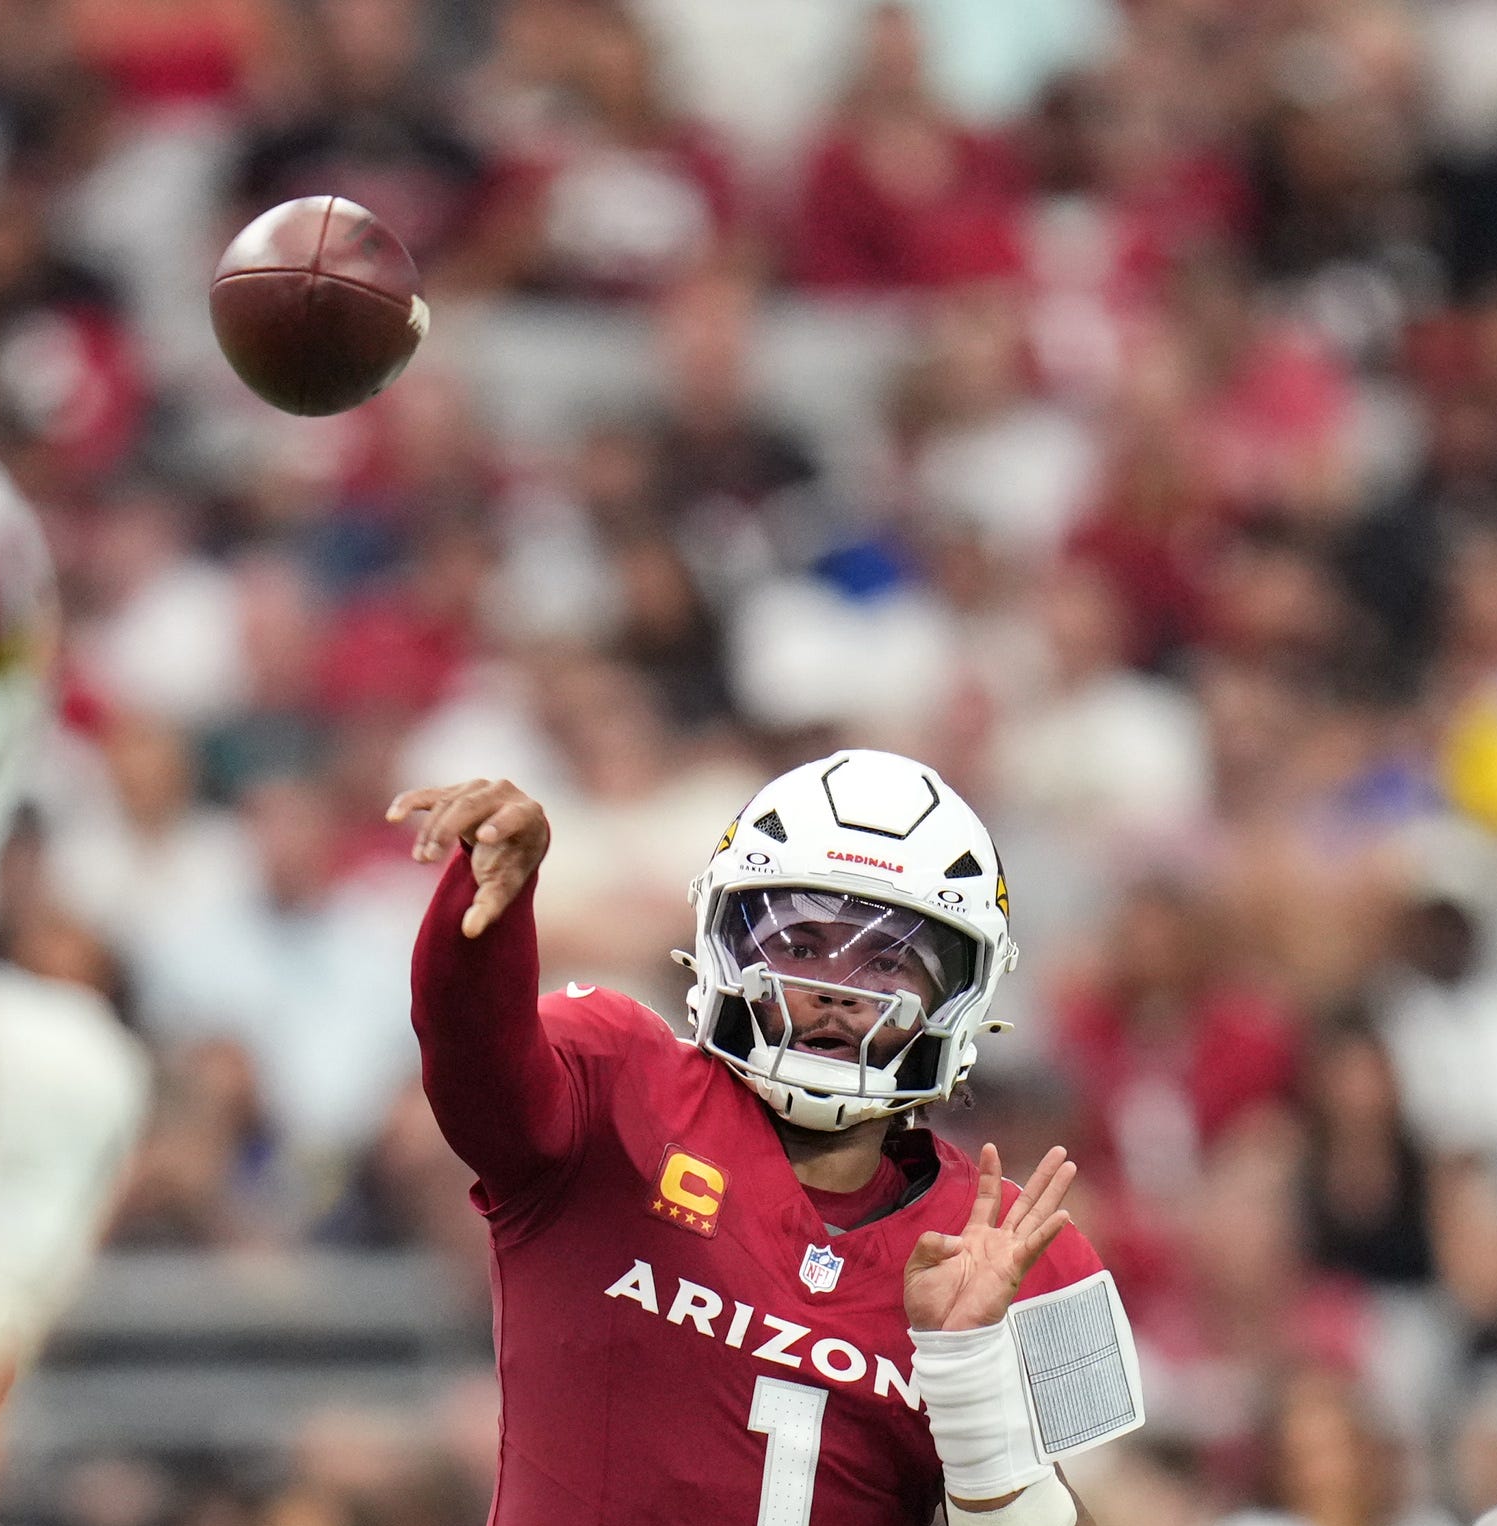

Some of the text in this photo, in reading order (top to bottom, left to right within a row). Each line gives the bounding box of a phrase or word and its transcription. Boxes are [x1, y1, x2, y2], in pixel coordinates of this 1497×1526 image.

[739, 864, 775, 875] OAKLEY
[826, 851, 904, 874] CARDINALS
[660, 1153, 725, 1216] C
[806, 1262, 831, 1285] NFL
[604, 1258, 922, 1412] ARIZON
